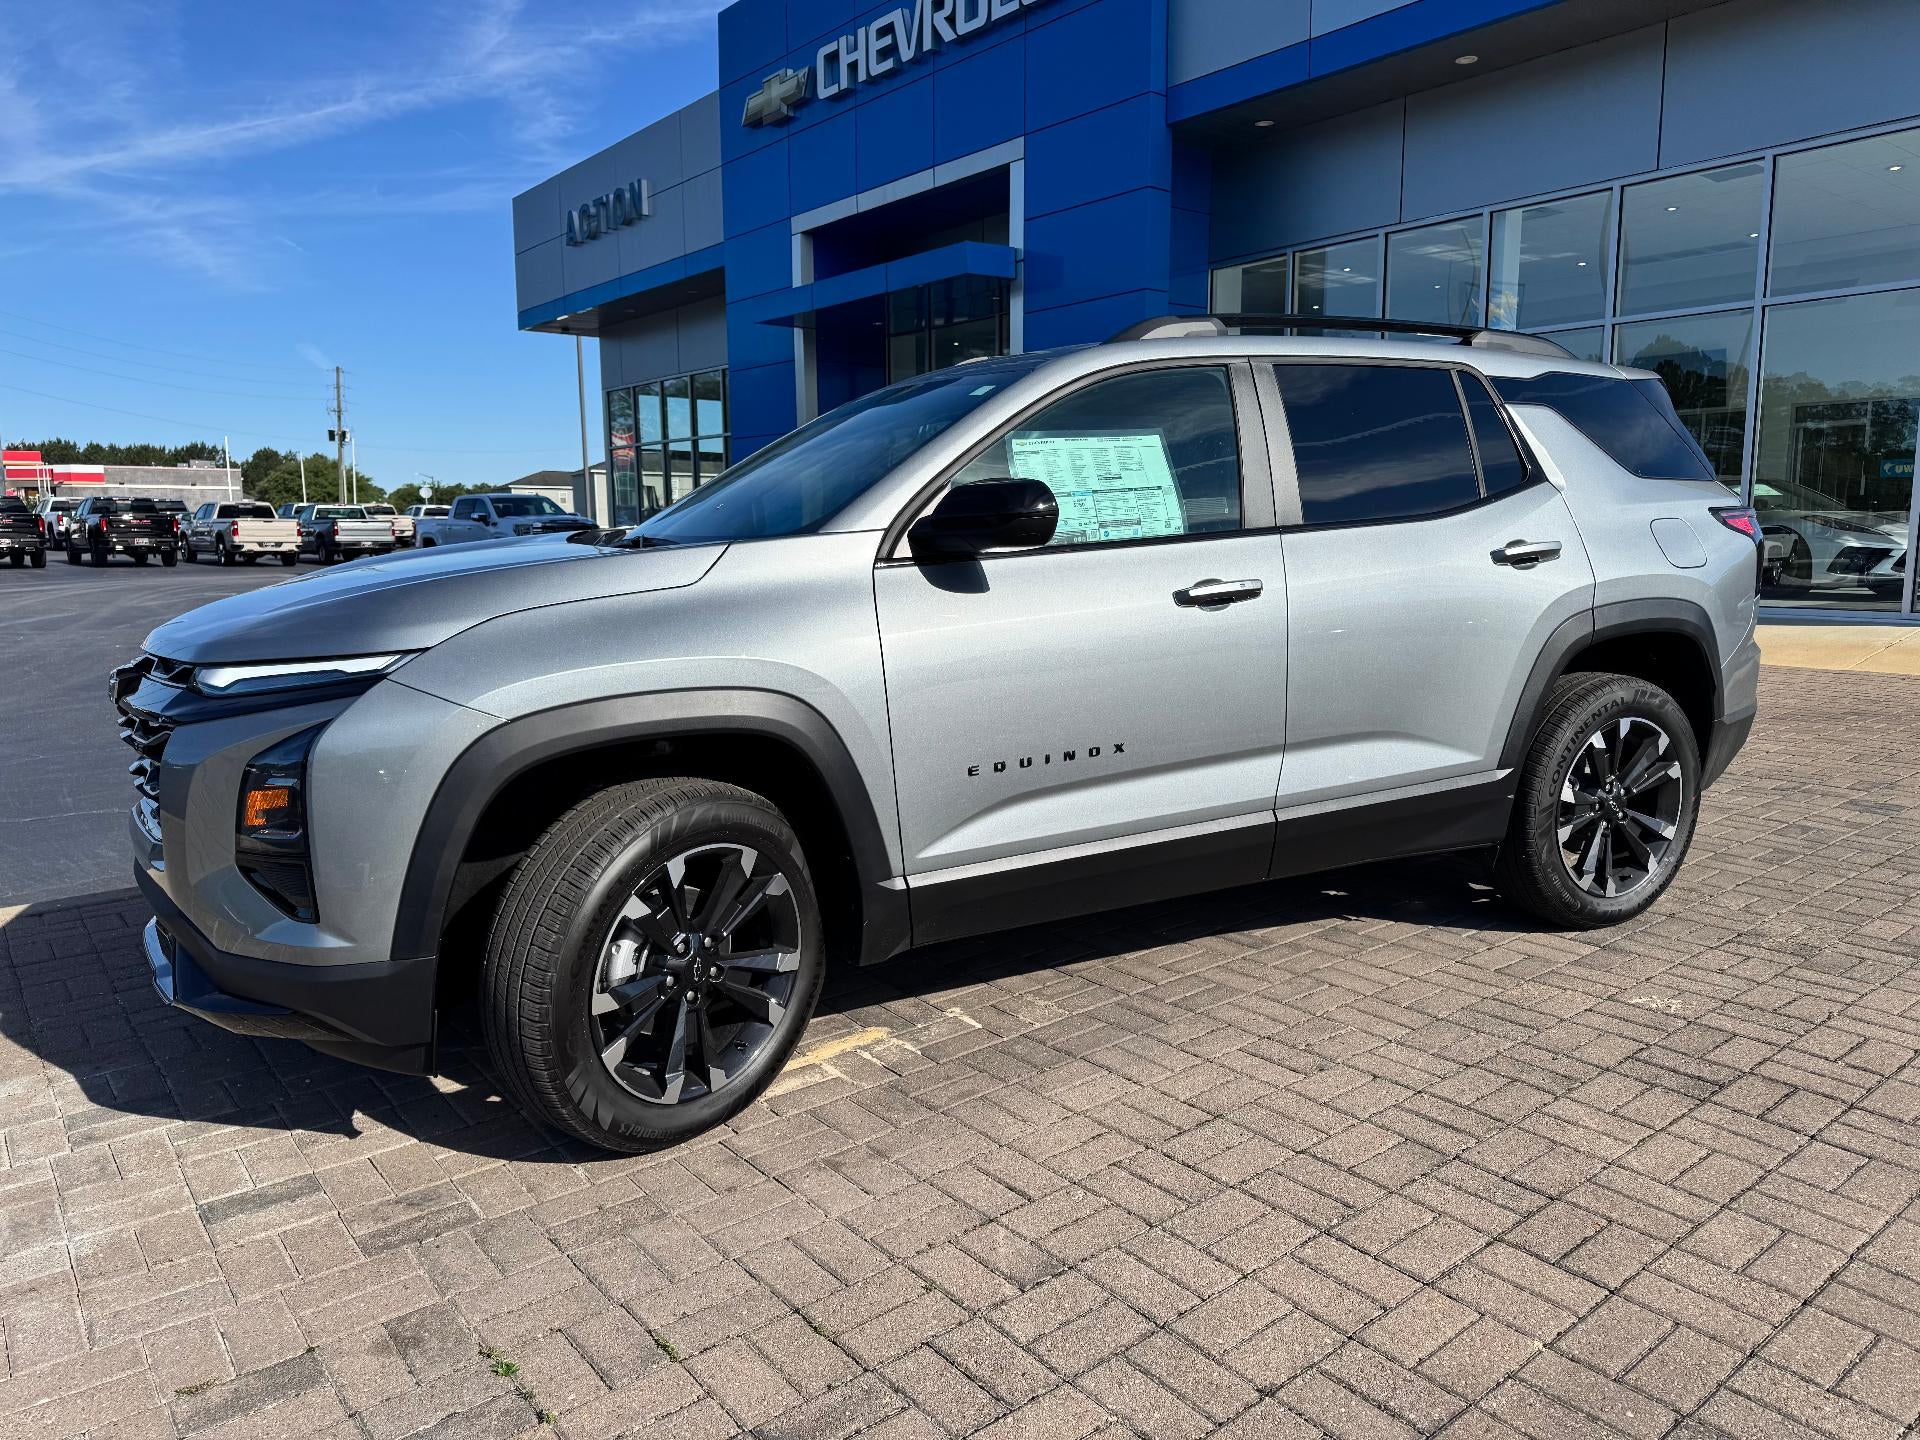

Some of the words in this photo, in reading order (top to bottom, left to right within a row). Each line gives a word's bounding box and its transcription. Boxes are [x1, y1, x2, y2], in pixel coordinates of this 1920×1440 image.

[816, 0, 1037, 100] CHEVRO
[566, 178, 648, 246] ACTION
[968, 743, 1125, 777] EQUINOX
[1549, 697, 1628, 797] CONTINENTAL
